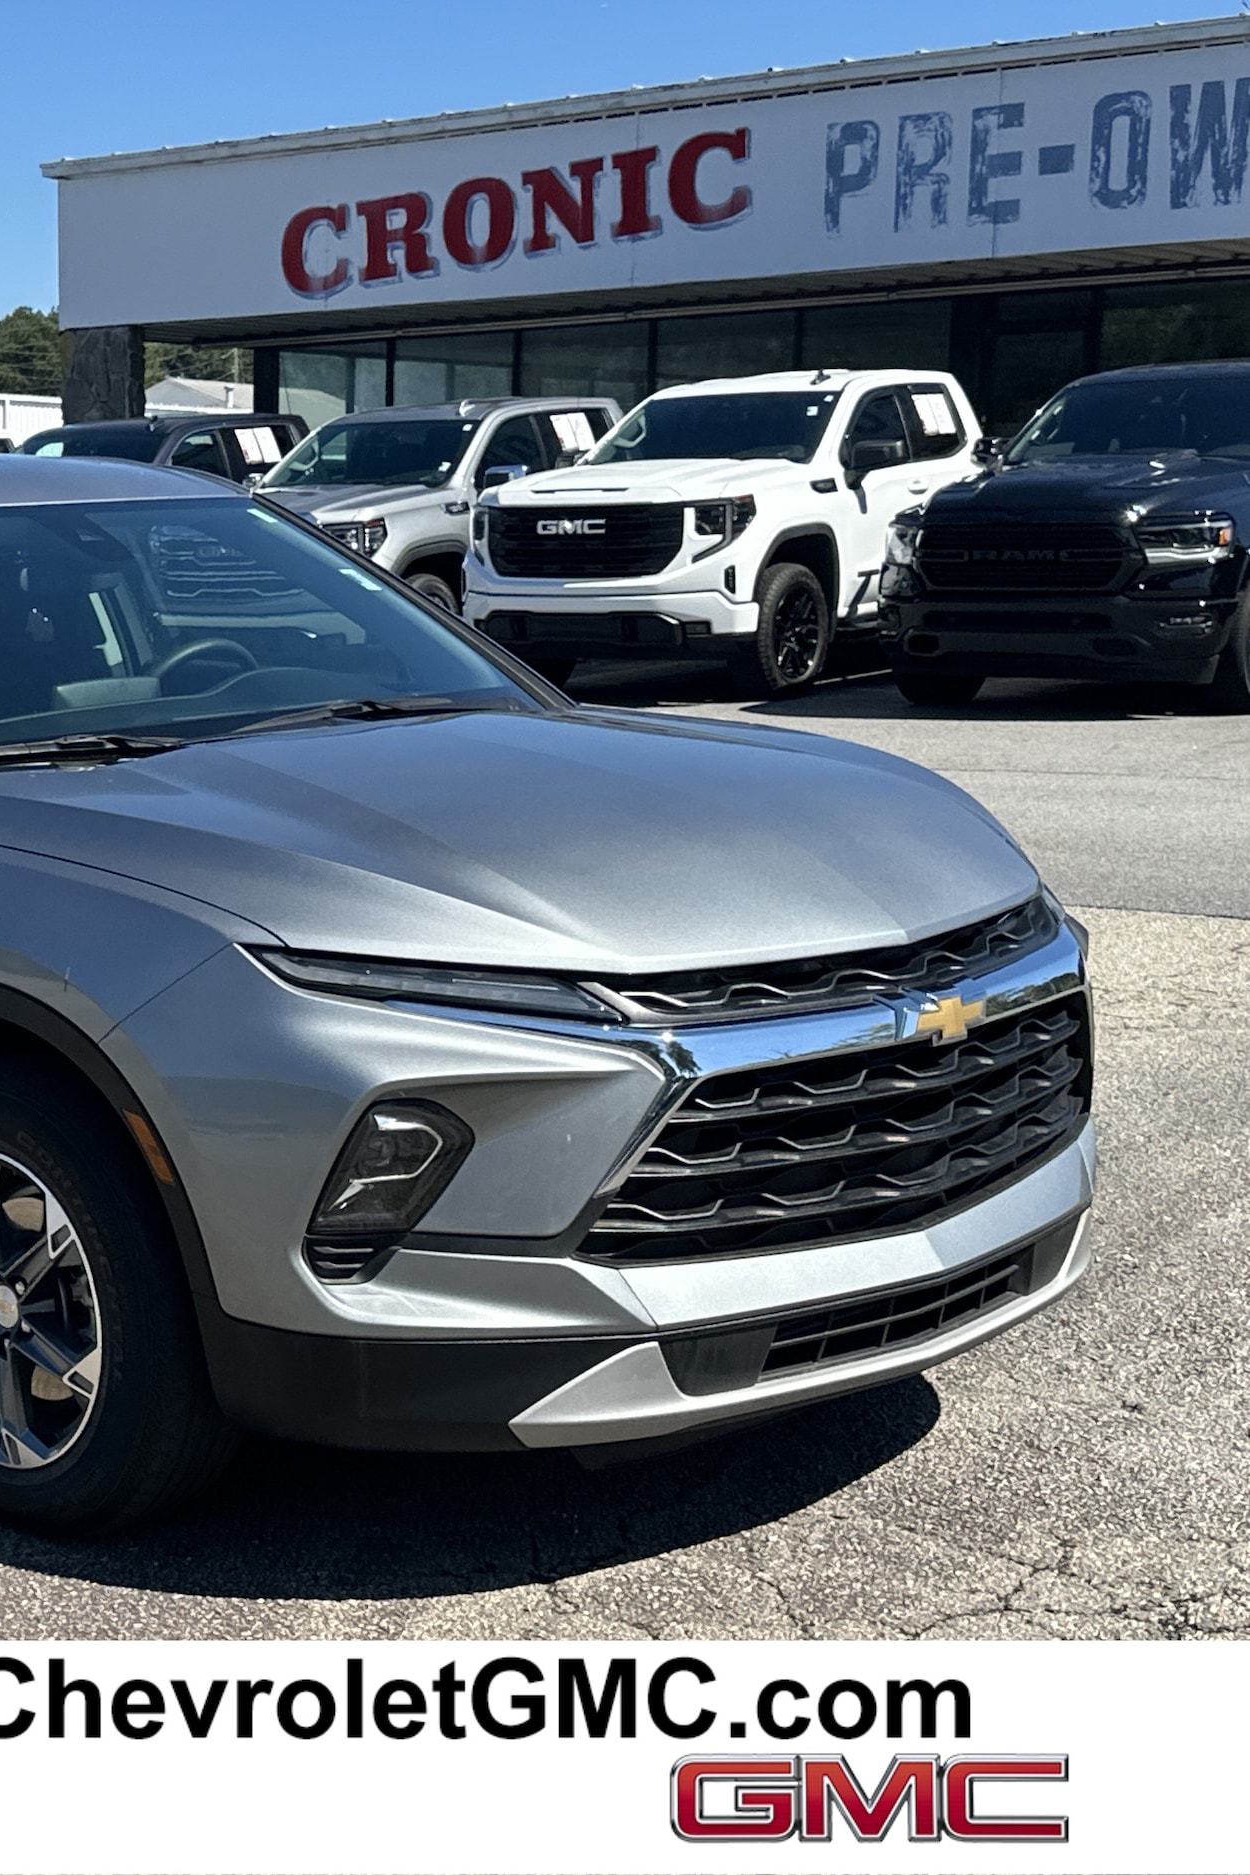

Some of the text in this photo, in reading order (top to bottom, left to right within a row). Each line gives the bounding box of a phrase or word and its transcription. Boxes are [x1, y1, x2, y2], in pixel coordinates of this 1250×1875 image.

[281, 127, 753, 300] CRONIC
[536, 518, 607, 535] GMC
[972, 549, 1055, 561] RAM
